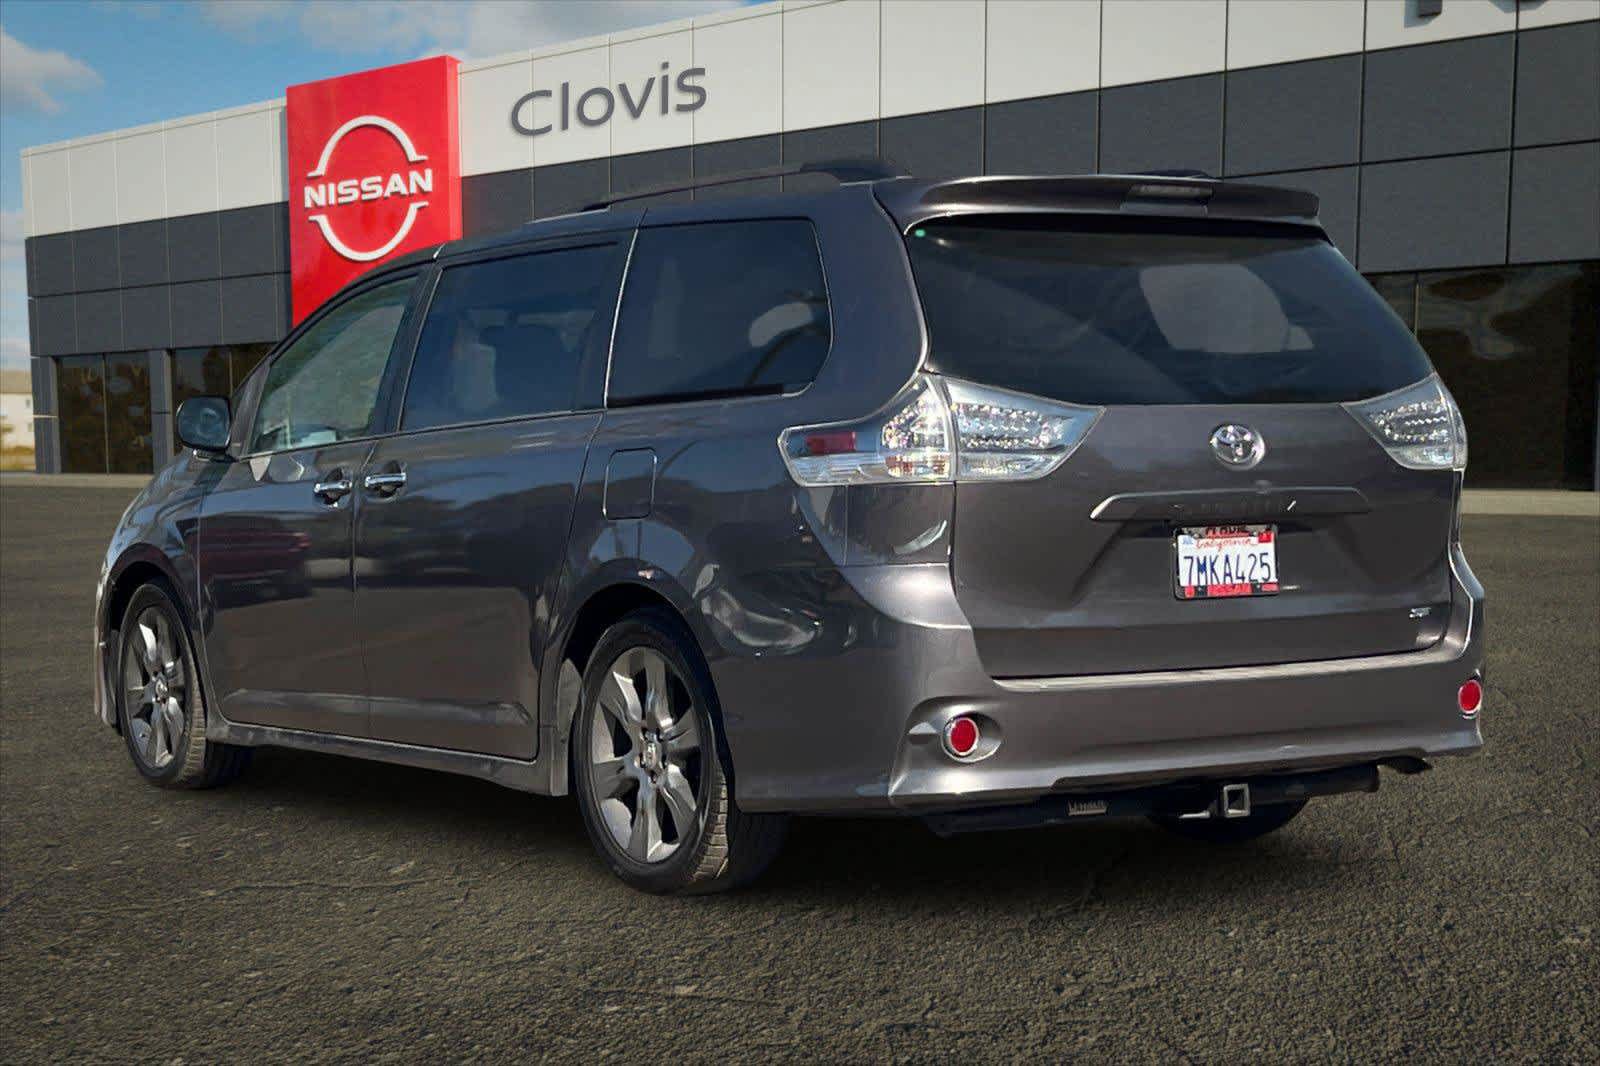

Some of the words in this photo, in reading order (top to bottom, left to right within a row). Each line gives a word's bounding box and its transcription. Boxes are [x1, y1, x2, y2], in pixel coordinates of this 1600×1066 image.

[511, 62, 707, 136] Clovis
[304, 168, 433, 208] NISSAN
[1183, 552, 1271, 586] 7MKA425
